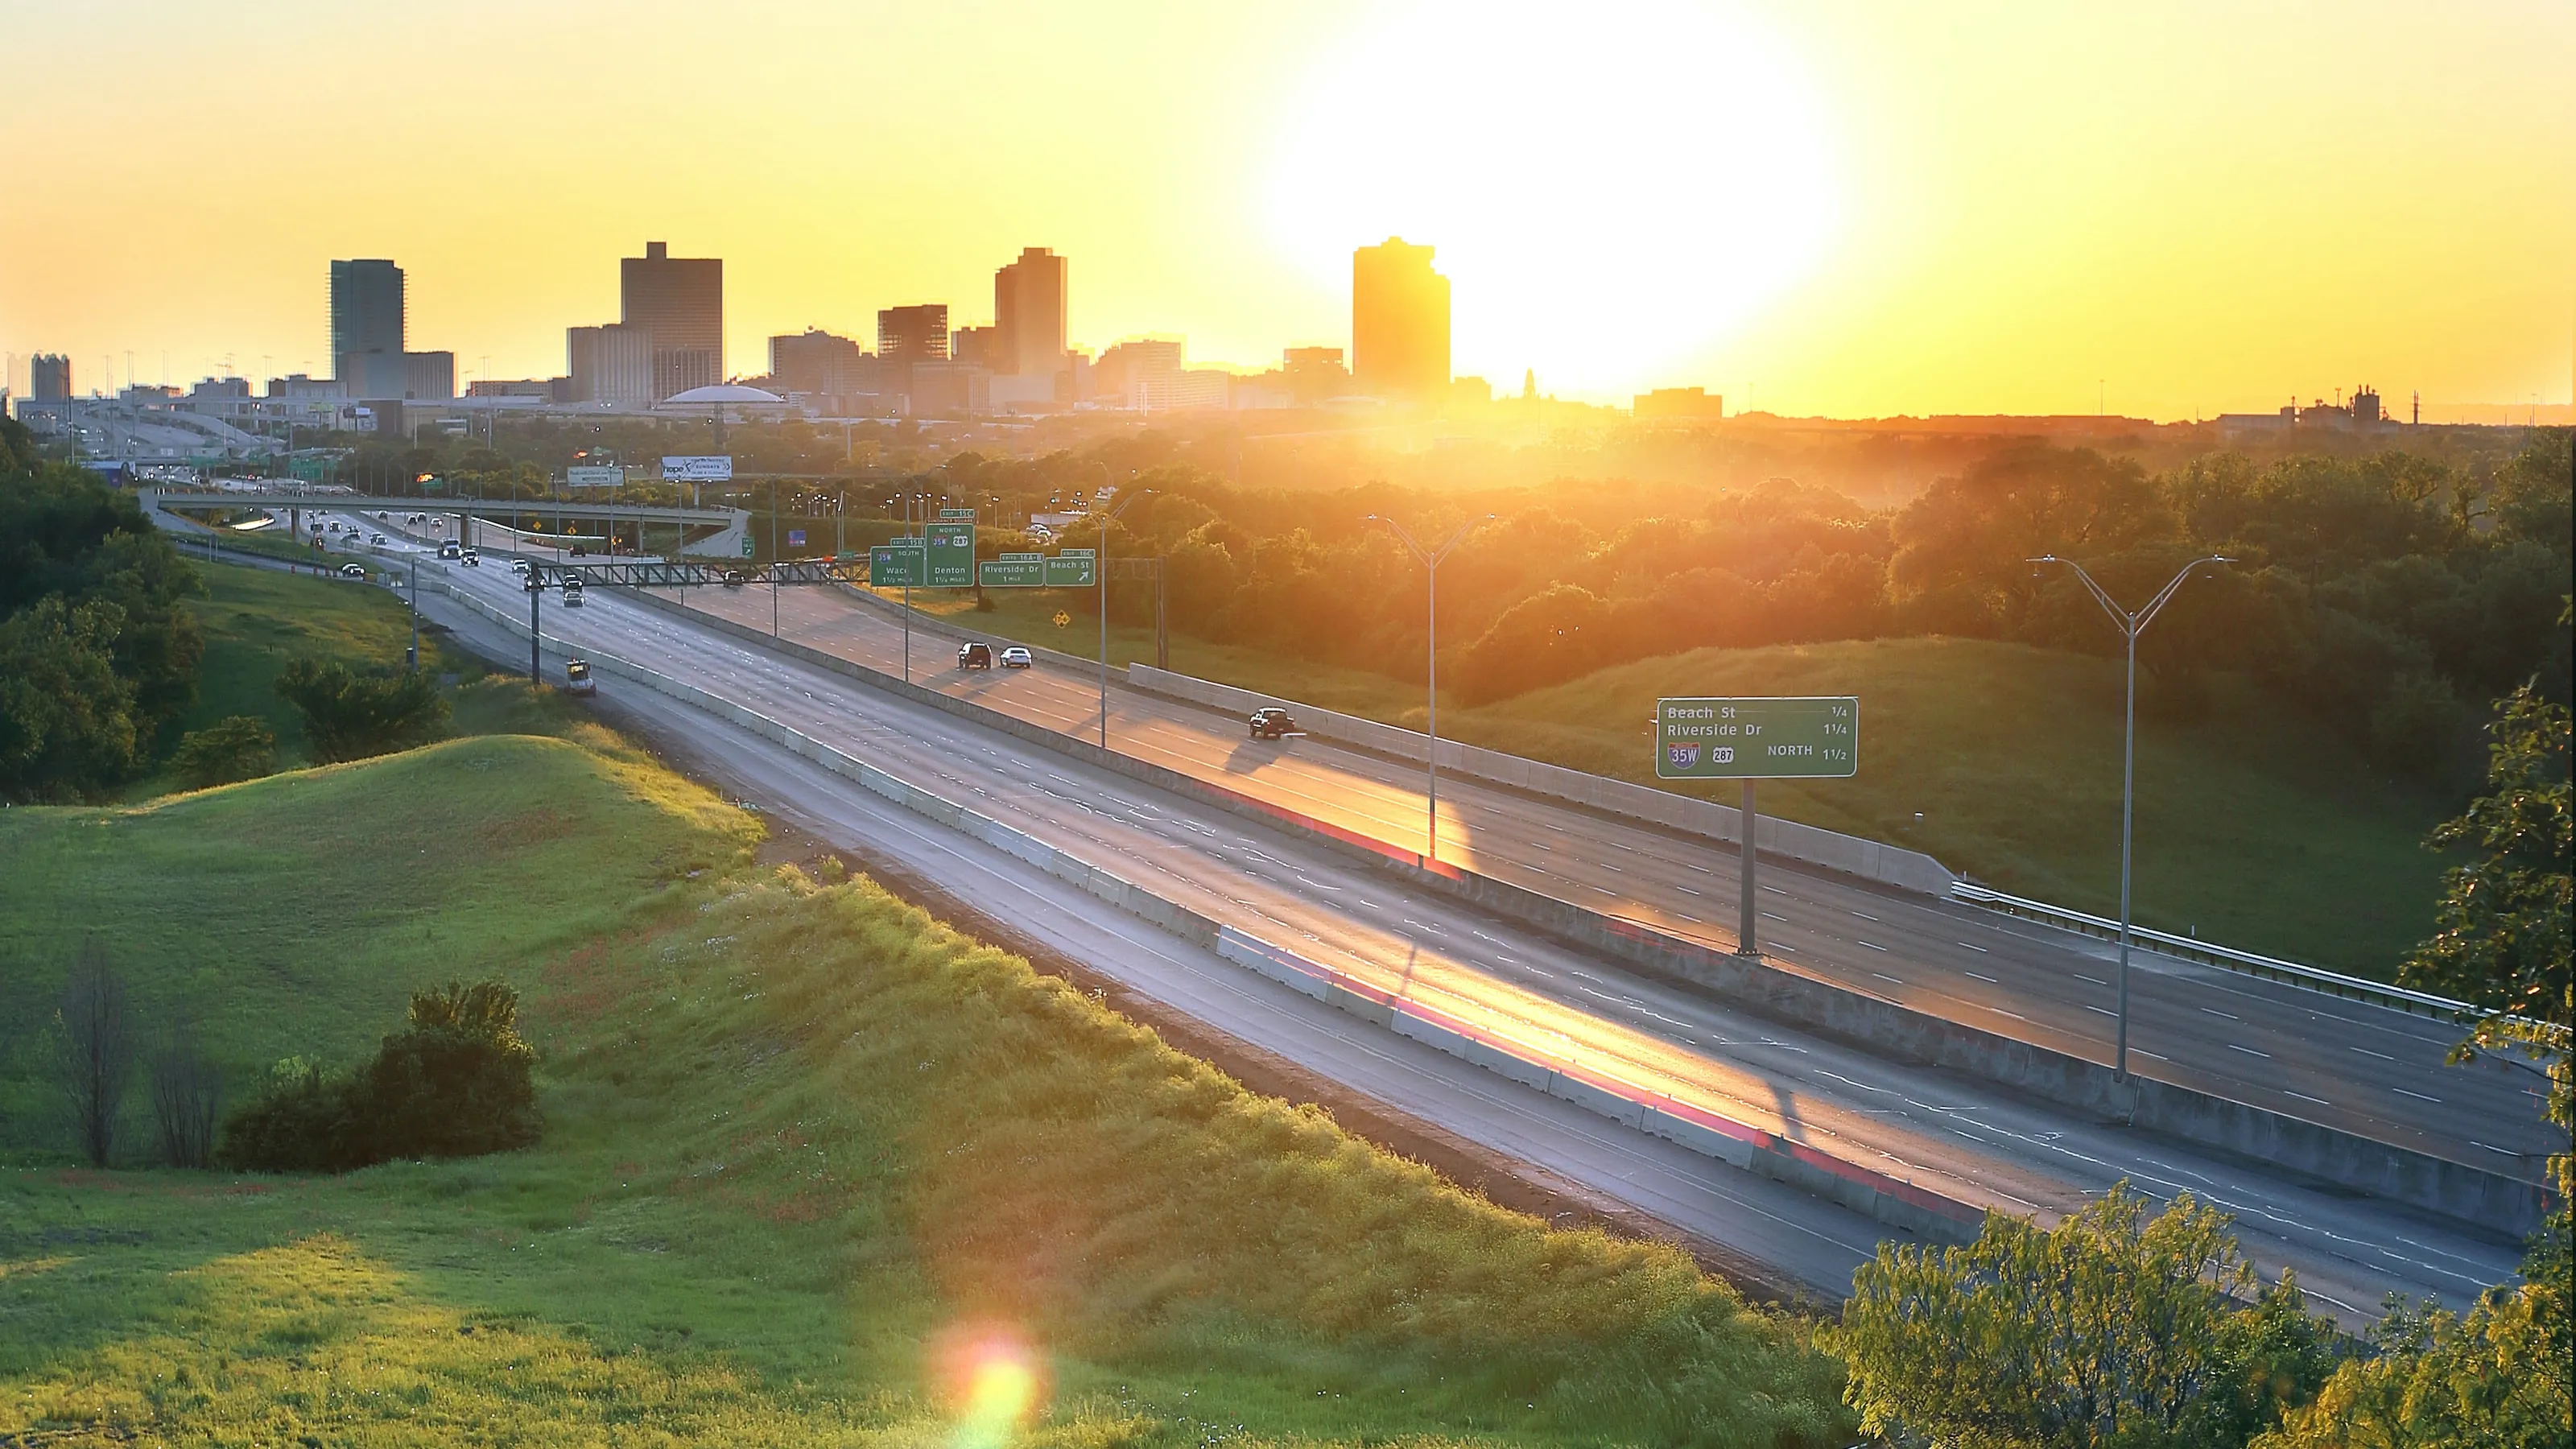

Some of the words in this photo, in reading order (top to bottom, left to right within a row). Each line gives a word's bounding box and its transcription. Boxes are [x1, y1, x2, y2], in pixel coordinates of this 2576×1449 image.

[663, 465, 684, 473] hope
[984, 565, 1025, 573] Riverside
[1028, 565, 1039, 573] Dr
[1051, 561, 1077, 569] Beach
[1080, 561, 1089, 569] St
[1668, 707, 1713, 719] Beach
[1721, 707, 1736, 719] St
[1667, 724, 1737, 736] Riverside
[1745, 724, 1762, 736] Dr
[1672, 749, 1697, 762] 35W
[1714, 750, 1732, 761] 287
[1768, 745, 1813, 755] NORTH
